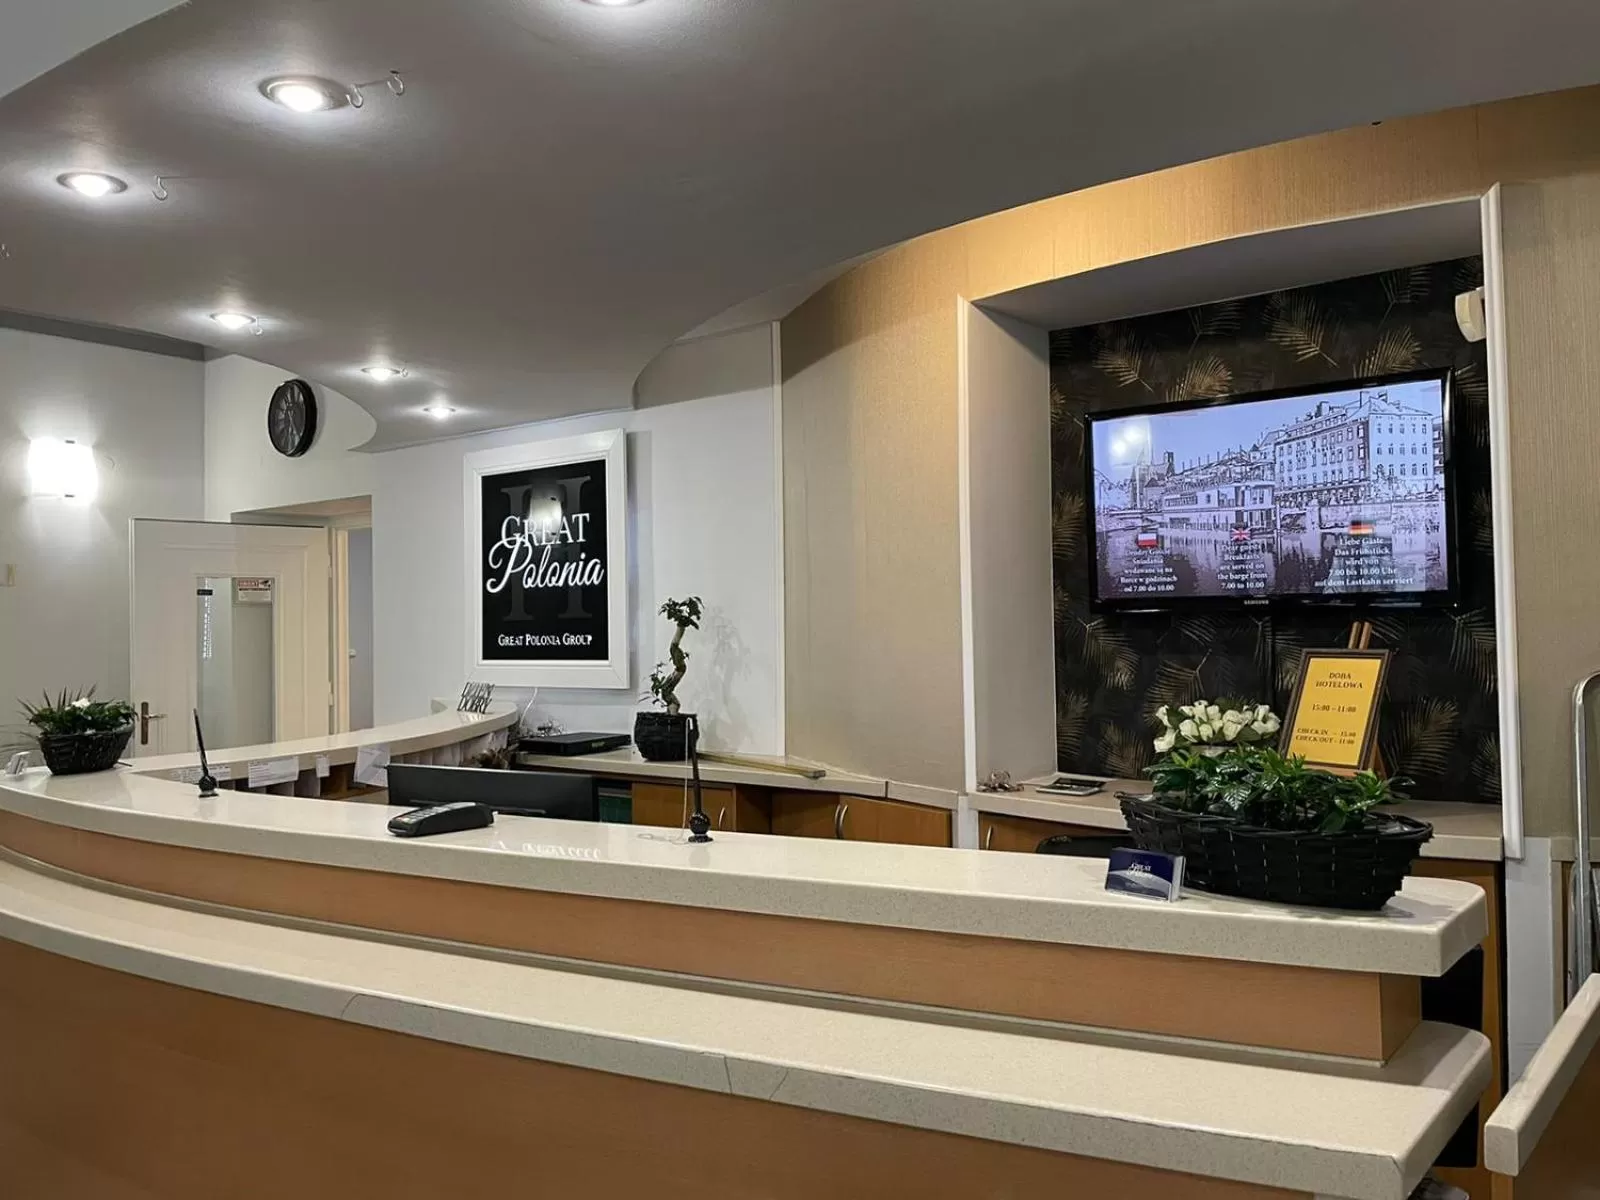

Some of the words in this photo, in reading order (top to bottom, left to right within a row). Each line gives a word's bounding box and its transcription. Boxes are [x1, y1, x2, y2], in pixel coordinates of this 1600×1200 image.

[501, 513, 590, 549] GREAT
[486, 535, 605, 593] Polonia
[1217, 572, 1229, 580] the
[498, 633, 523, 646] GREAT
[525, 633, 561, 646] POLONIA
[562, 632, 592, 646] GROUP
[1315, 681, 1363, 689] HOTELOWA
